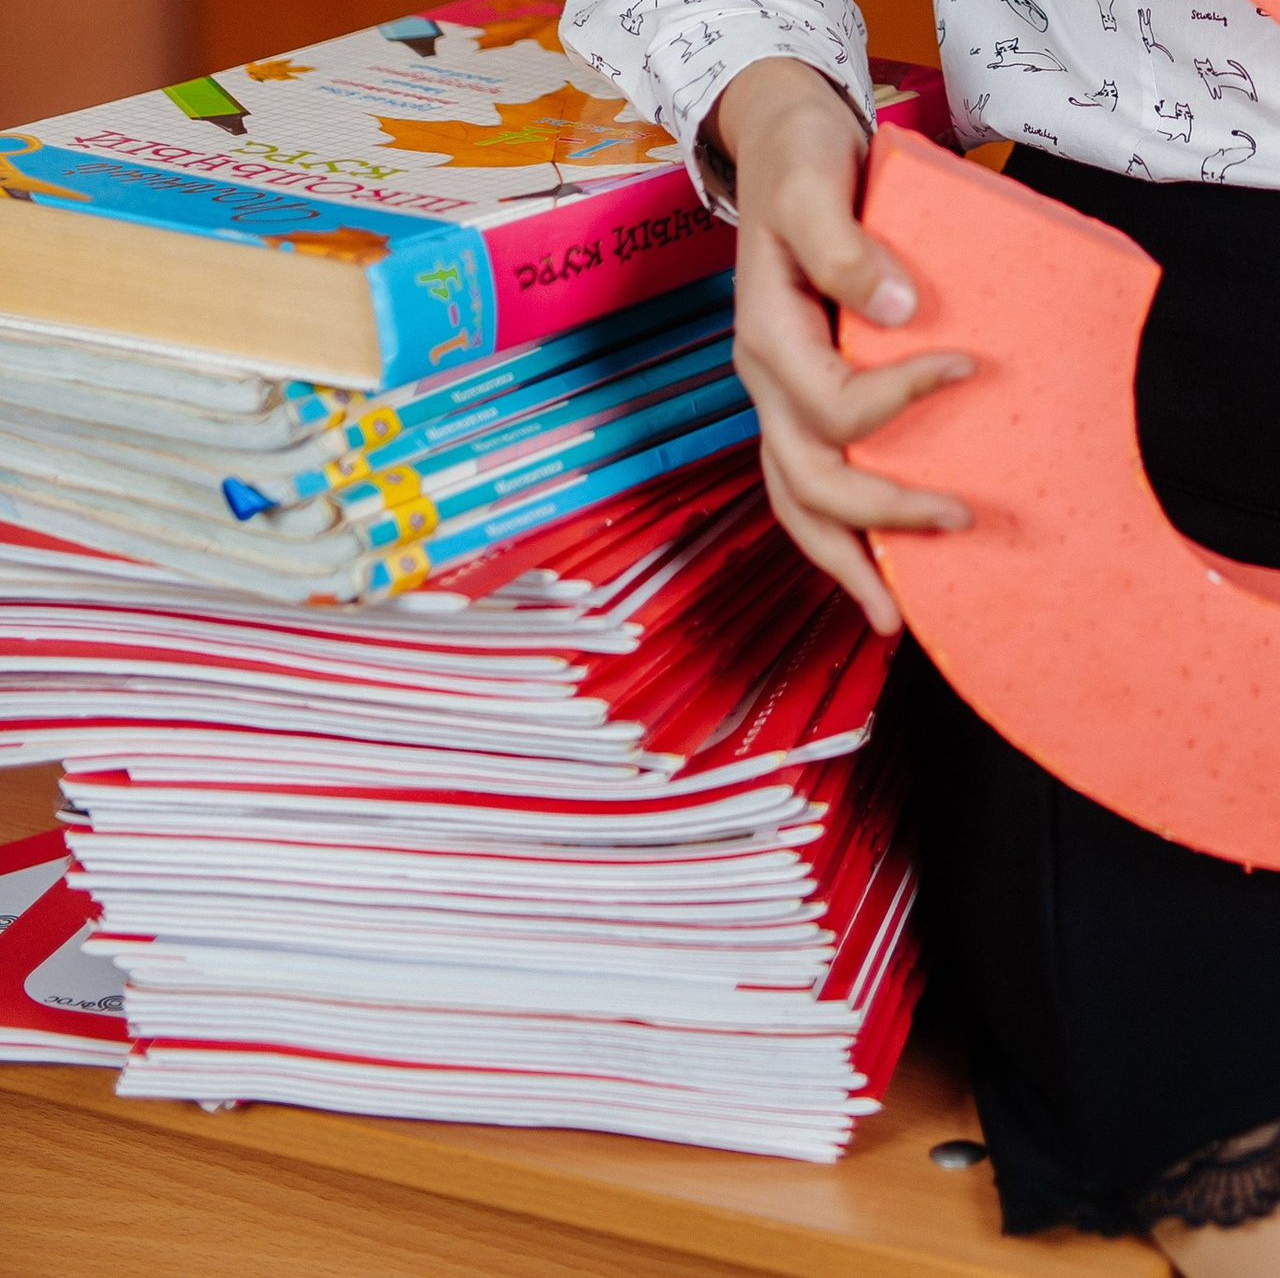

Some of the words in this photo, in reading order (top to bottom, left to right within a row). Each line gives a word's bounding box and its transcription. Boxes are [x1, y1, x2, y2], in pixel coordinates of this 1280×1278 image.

[67, 129, 477, 214] ШКОЛЬНЫЙ
[229, 140, 409, 181] КУРС
[61, 162, 321, 223] Полный
[514, 238, 605, 291] КУРС
